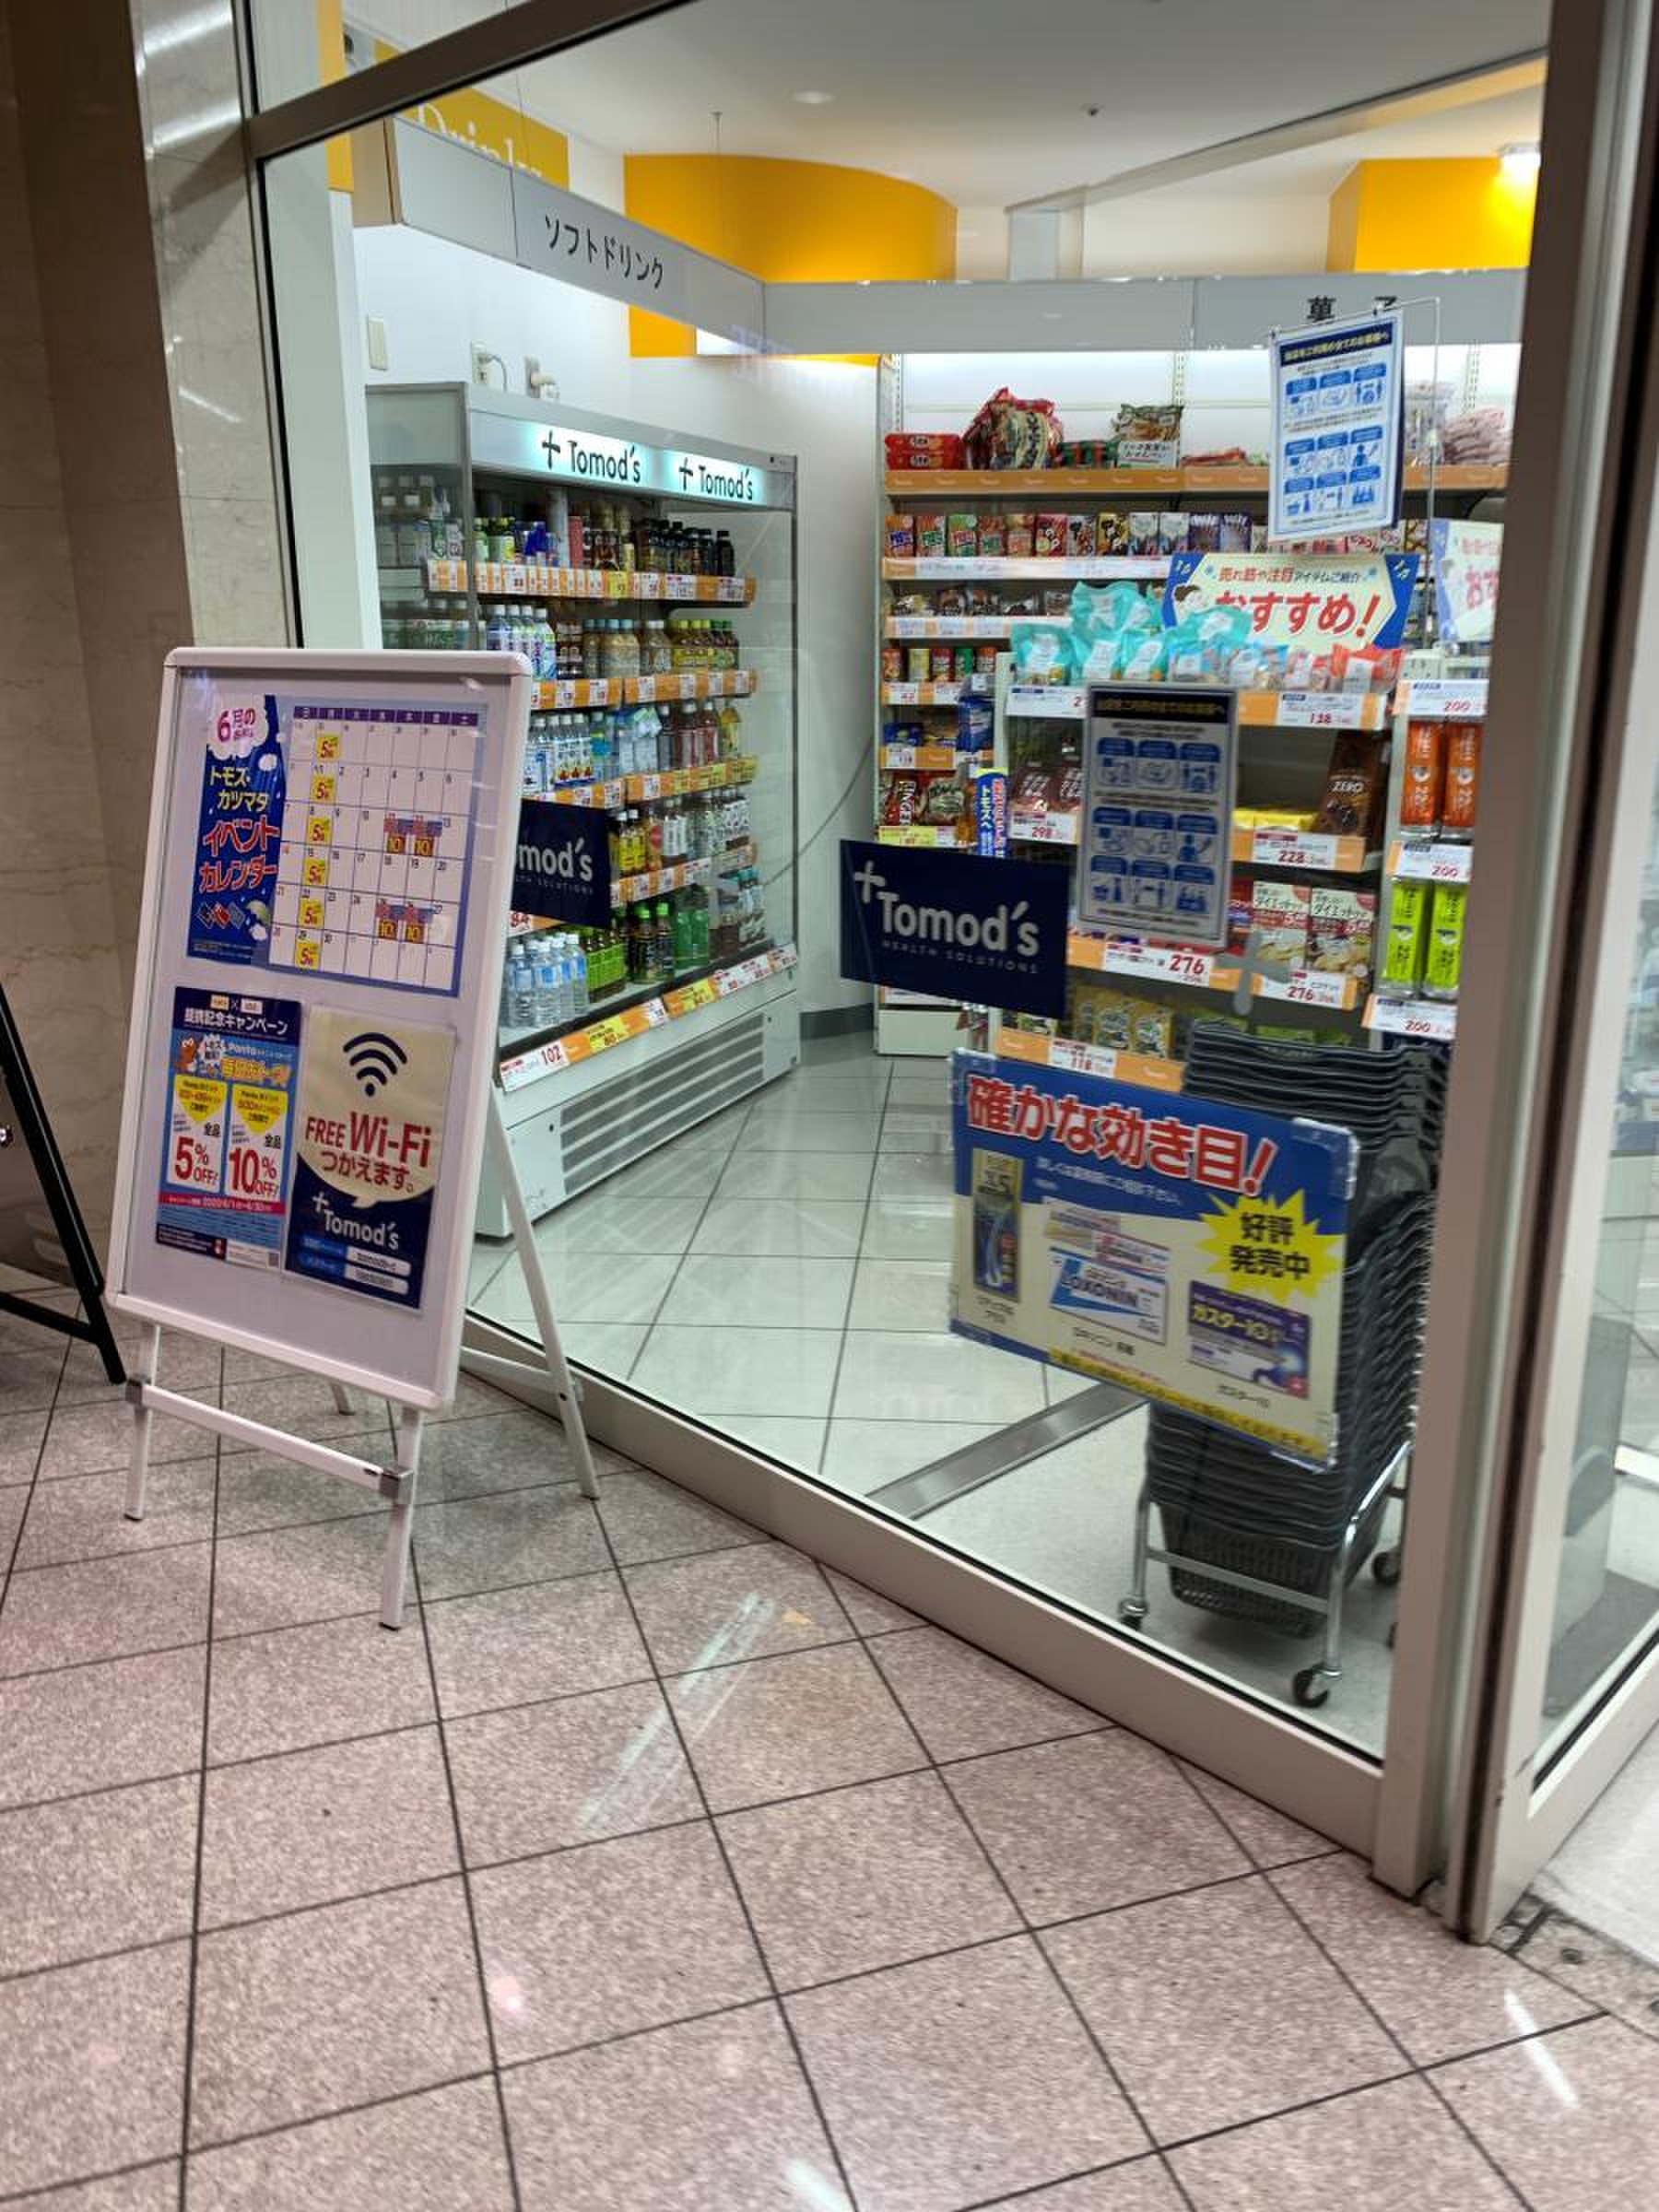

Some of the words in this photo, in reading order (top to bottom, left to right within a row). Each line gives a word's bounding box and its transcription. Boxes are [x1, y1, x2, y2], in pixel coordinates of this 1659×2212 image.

[544, 213, 665, 288] ソフトドリンク
[567, 439, 642, 485] Tomod's
[698, 465, 754, 501] Tomod's
[218, 788, 269, 812] カツマタ
[202, 814, 281, 857] イベント
[198, 853, 279, 894] カレンダー
[518, 837, 593, 883] mod's
[877, 890, 1041, 958] Tomod's
[1169, 954, 1206, 975] 276
[1287, 986, 1314, 1001] 276
[541, 1045, 562, 1065] 102
[305, 1114, 346, 1149] FREE
[349, 1112, 432, 1168] Wi-Fi
[966, 1073, 1279, 1198] 確かな効き目!
[321, 1149, 415, 1194] つかえます。
[324, 1208, 400, 1252] Tomod's
[1240, 1211, 1296, 1245] 好評
[1229, 1244, 1312, 1282] 発売中
